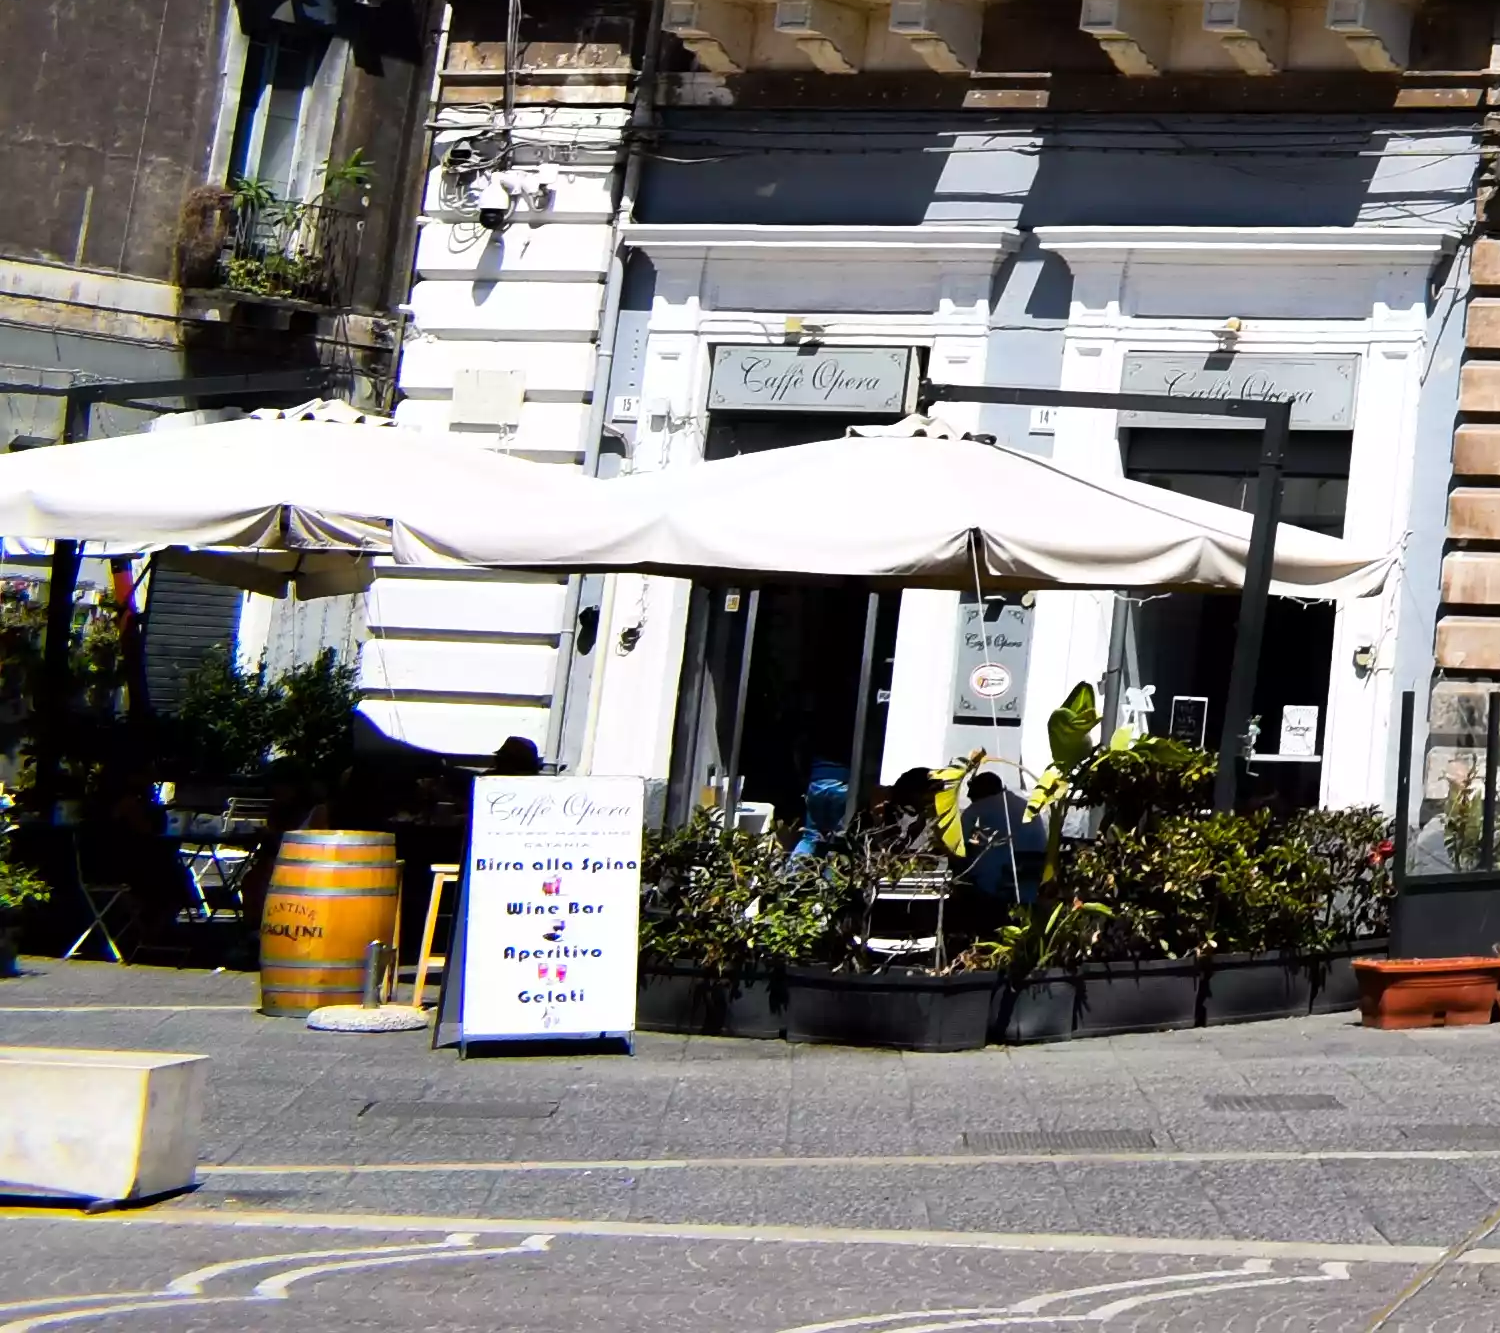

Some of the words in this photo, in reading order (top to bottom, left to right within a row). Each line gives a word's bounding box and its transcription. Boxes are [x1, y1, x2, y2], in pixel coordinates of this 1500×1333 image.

[812, 358, 881, 401] Opera
[622, 398, 632, 412] 15
[1039, 409, 1050, 424] 14
[563, 792, 632, 826] Opera
[476, 858, 524, 871] Birra
[532, 857, 574, 871] alla
[581, 857, 637, 874] Spina
[506, 901, 560, 915] Wine
[568, 901, 604, 915] Bar
[503, 945, 603, 963] Aperitivo
[517, 989, 584, 1003] Gelati
